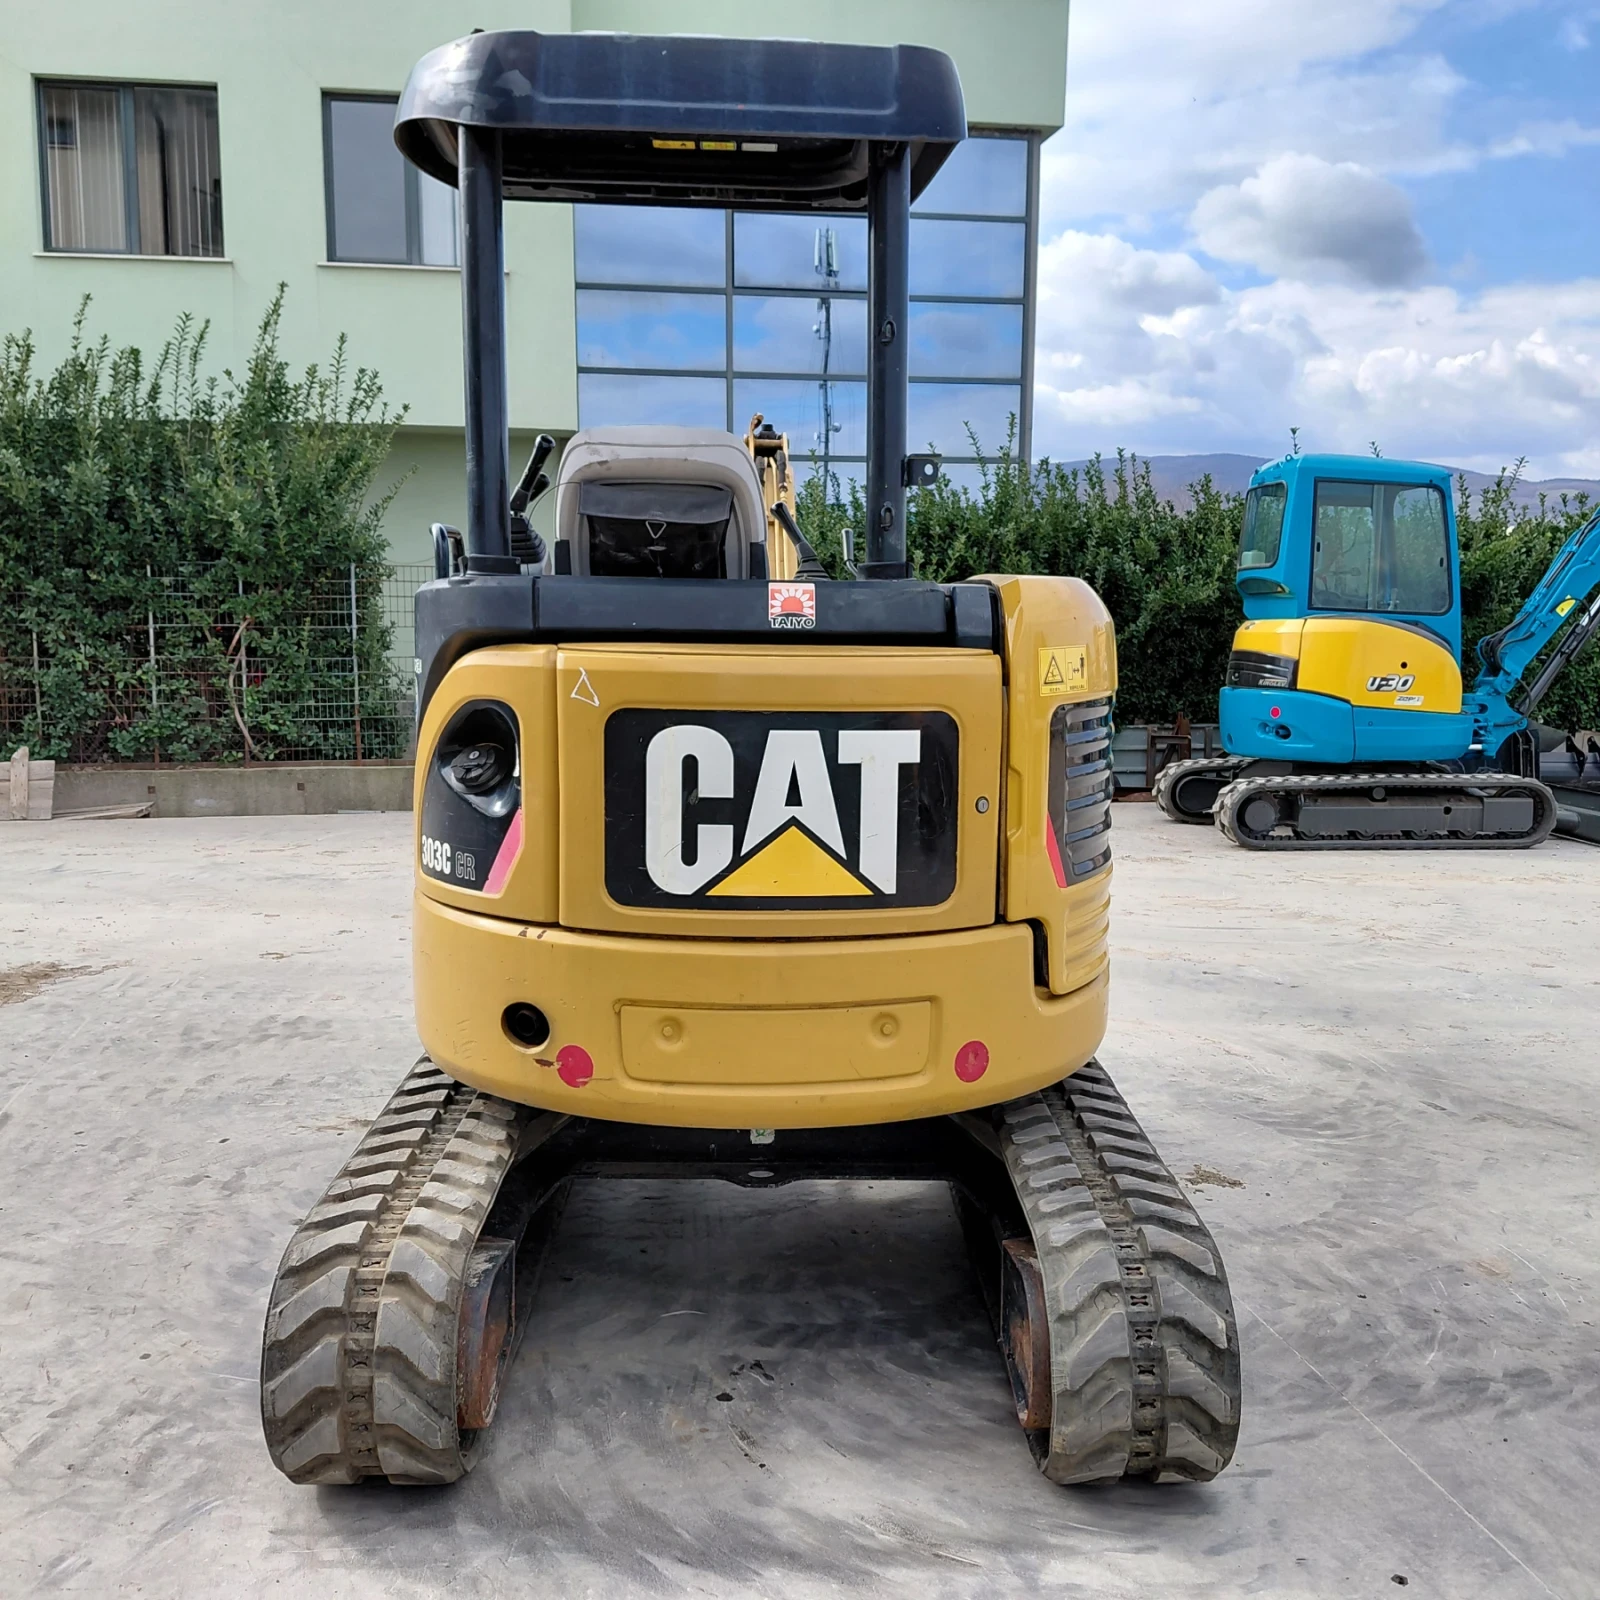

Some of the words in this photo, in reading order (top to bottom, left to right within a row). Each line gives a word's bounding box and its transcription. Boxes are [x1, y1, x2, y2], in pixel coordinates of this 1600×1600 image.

[770, 617, 815, 628] TAIYO
[1366, 674, 1415, 692] U-30
[646, 725, 921, 896] CAT
[422, 834, 451, 875] 303C
[455, 851, 476, 880] CR
